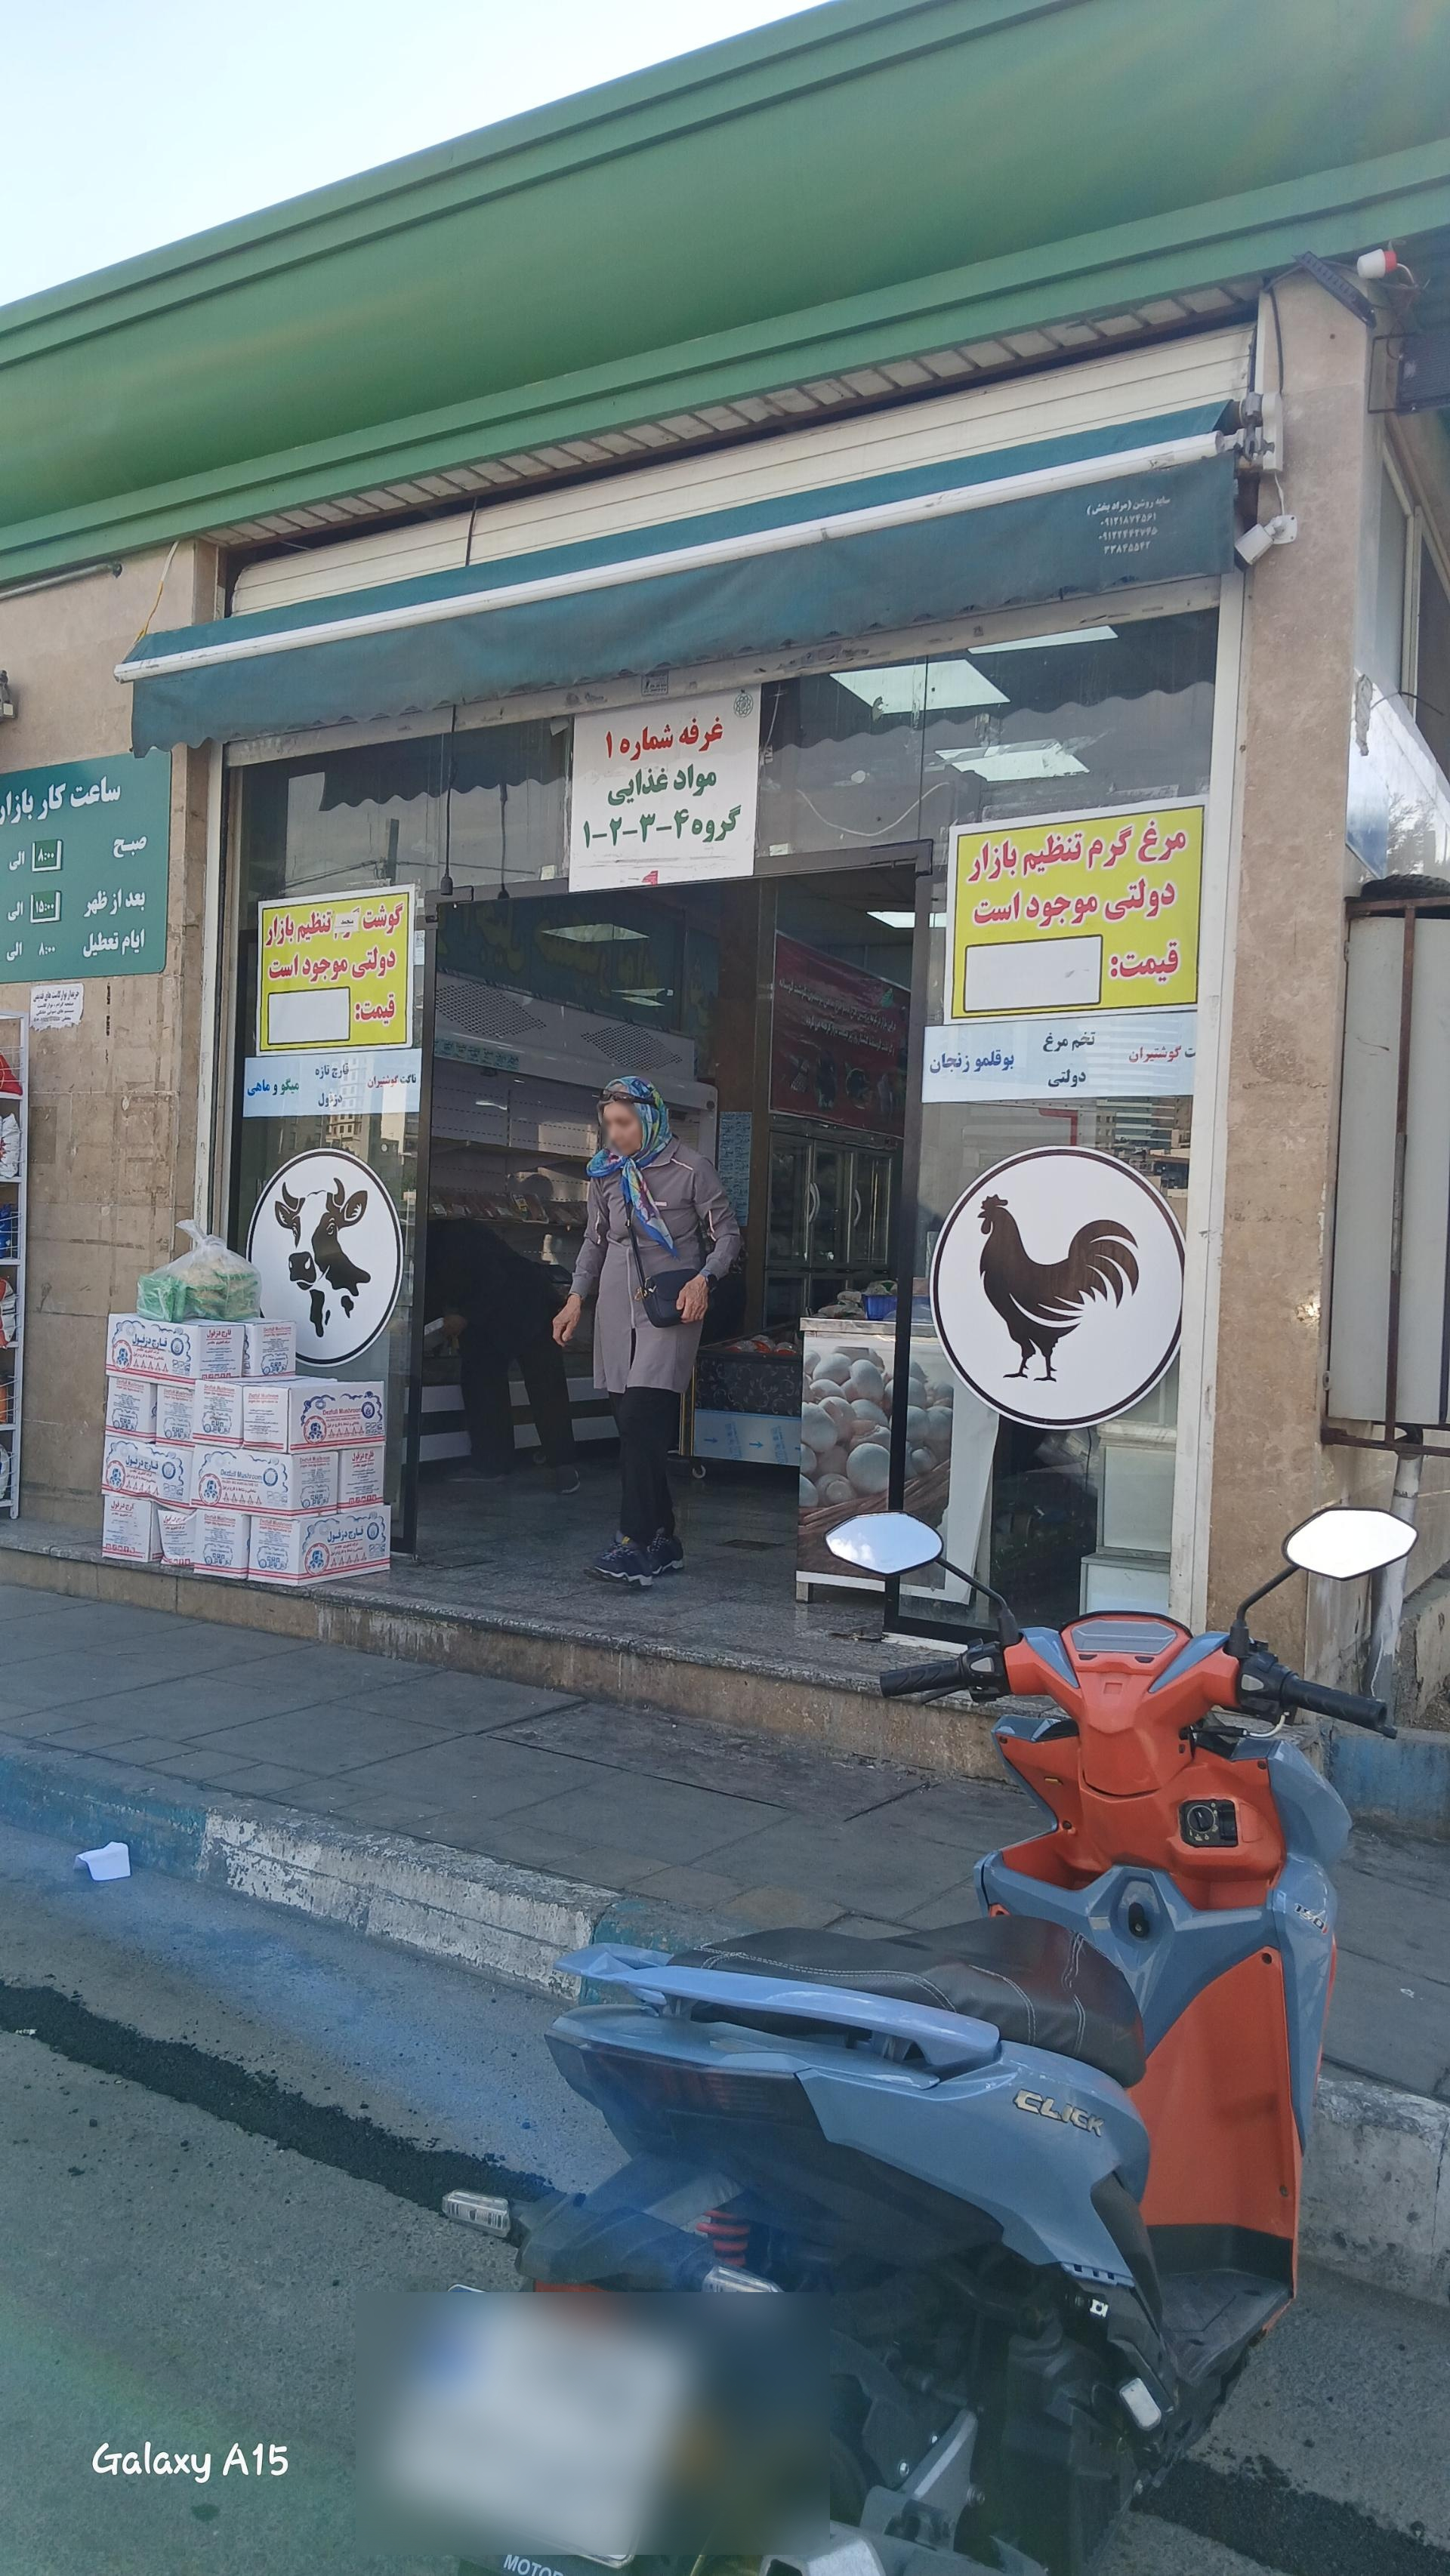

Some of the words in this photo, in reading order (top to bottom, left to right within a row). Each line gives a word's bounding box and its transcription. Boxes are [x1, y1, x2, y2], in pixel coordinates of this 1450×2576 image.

[606, 731, 613, 759] ۱
[619, 723, 674, 761] شماره
[678, 716, 723, 752] غرفه
[70, 776, 121, 808] ساعت
[607, 767, 668, 806] غذایی
[673, 763, 717, 797] مواد
[0, 787, 34, 825] بازار
[38, 782, 66, 821] کار
[691, 805, 742, 843] گروه
[113, 834, 147, 858] صبح
[1023, 831, 1083, 877] تنظیم
[1088, 826, 1133, 870] گرم
[1137, 821, 1186, 863] مرغ
[9, 850, 25, 870] الی
[967, 839, 1017, 882] بازار
[8, 901, 23, 921] الی
[84, 889, 108, 917] ظهر
[110, 889, 122, 915] از
[125, 890, 146, 911] بعد
[973, 891, 1021, 925] است
[1026, 893, 1097, 928] موجود
[1105, 877, 1176, 921] دولتی
[266, 914, 295, 946] بازار
[297, 910, 332, 943] تنظیم
[362, 902, 404, 935] گوشت
[6, 941, 23, 961] الی
[82, 932, 119, 957] تعطیل
[122, 929, 145, 955] ایام
[269, 954, 298, 978] است
[301, 958, 348, 982] موجود
[352, 945, 396, 978] دولتی
[1109, 940, 1180, 982] قیمت:
[354, 994, 395, 1025] قیمت:
[1043, 1032, 1069, 1052] مرغ
[1072, 1031, 1096, 1051] تخم
[315, 1063, 330, 1080] تازه
[332, 1062, 350, 1079] قارچ
[930, 1052, 970, 1074] زنجان
[973, 1049, 1014, 1072] بوقلمو
[247, 1078, 270, 1096] ماهی
[273, 1084, 278, 1095] و
[280, 1078, 300, 1096] میگو
[1047, 1068, 1086, 1088] دولتی
[1013, 2088, 1105, 2137] CLICK
